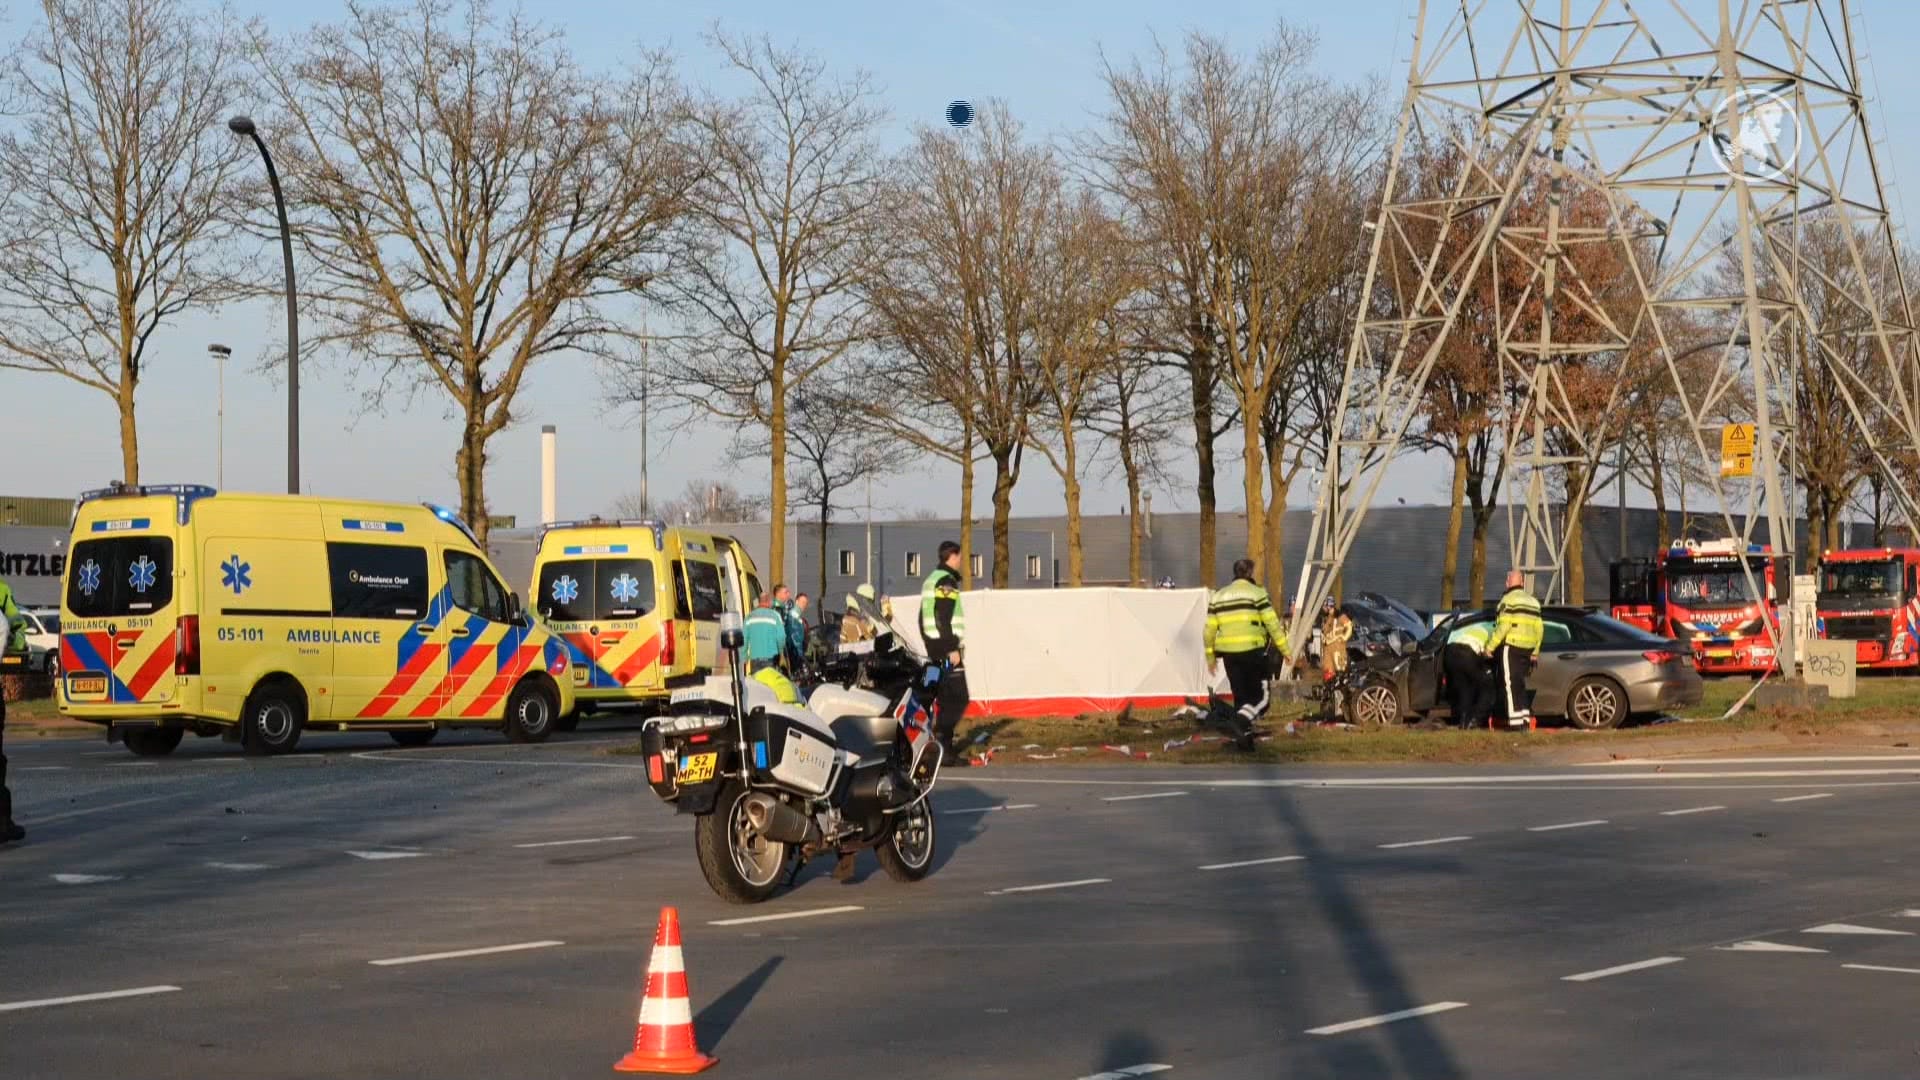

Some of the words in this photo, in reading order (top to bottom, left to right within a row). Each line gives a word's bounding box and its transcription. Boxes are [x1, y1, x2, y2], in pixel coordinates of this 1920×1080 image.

[359, 575, 393, 584] Ambulance
[61, 619, 108, 630] AMBULANCE
[127, 618, 153, 628] 05-101
[217, 627, 265, 641] 05-101
[286, 629, 381, 644] AMBULANCE
[694, 755, 709, 767] 52
[677, 766, 713, 781] MP-TH
